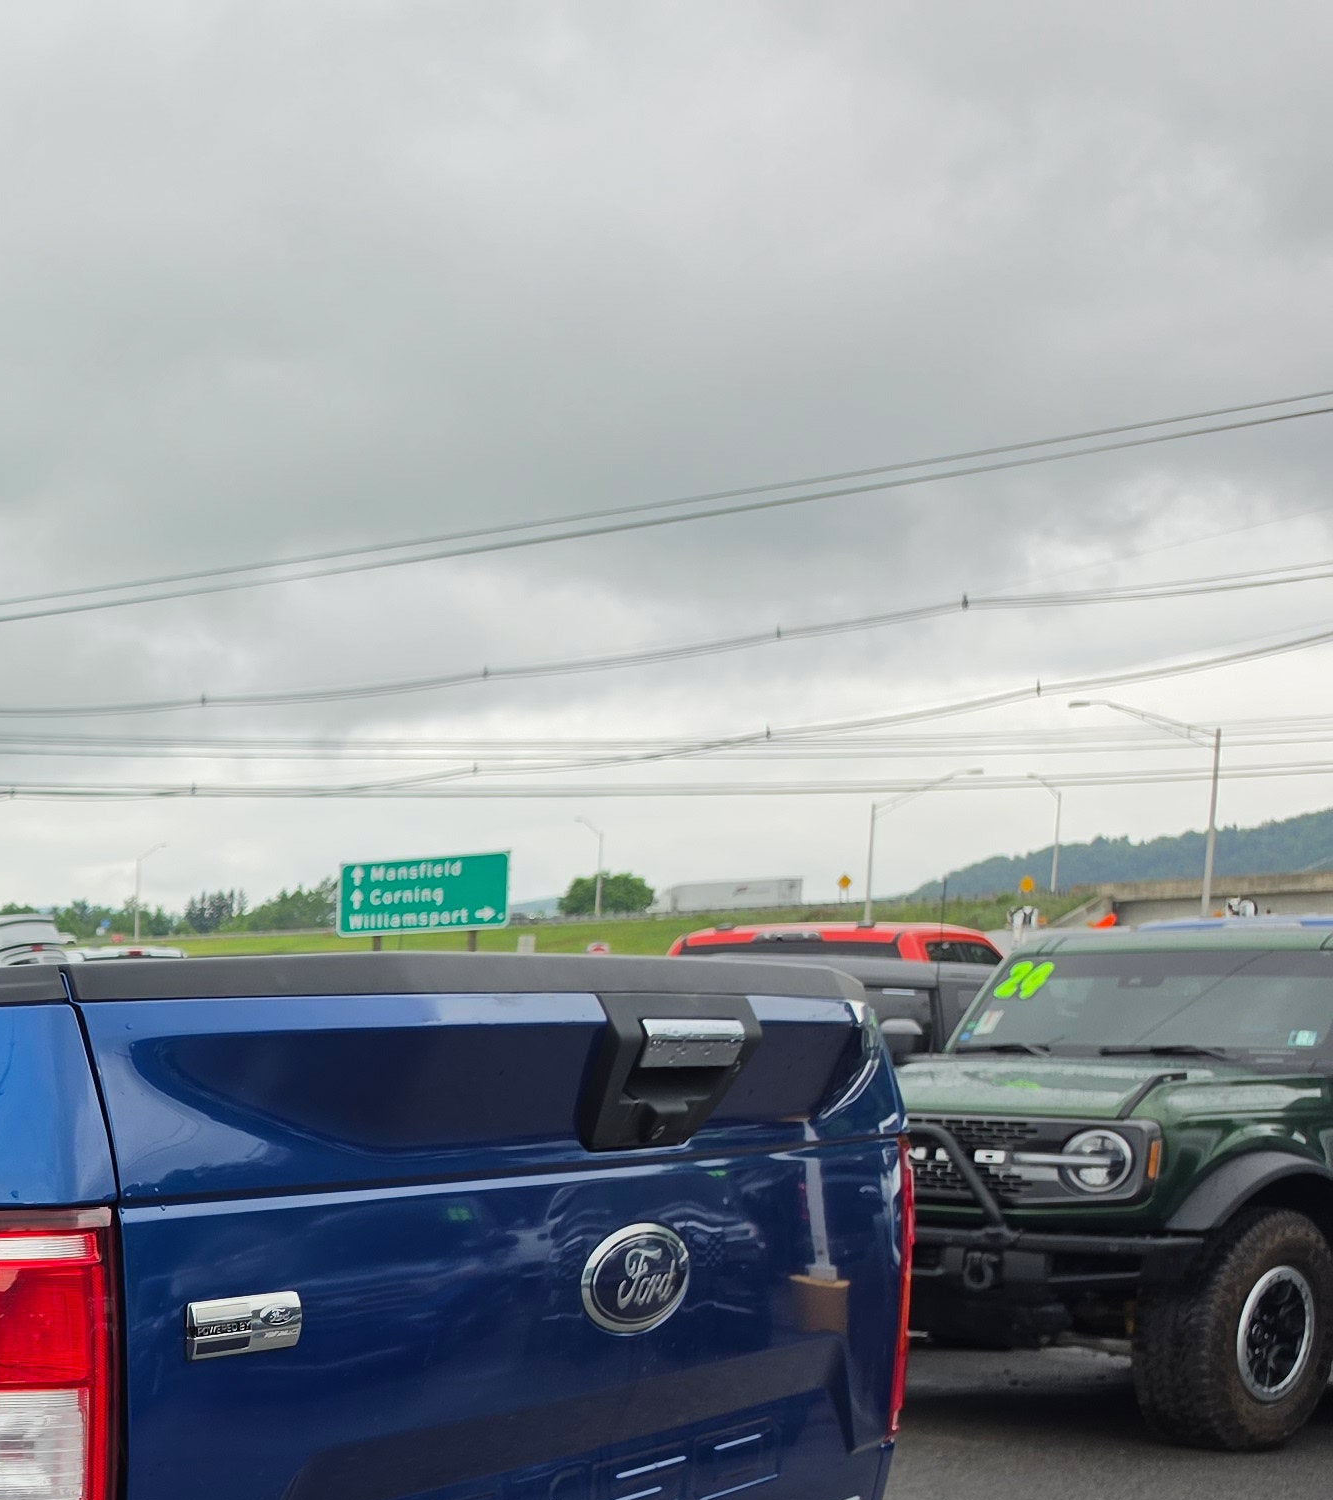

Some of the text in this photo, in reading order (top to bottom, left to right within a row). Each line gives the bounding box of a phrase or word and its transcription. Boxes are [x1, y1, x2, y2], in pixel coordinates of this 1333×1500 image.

[370, 860, 462, 882] Mansfield
[369, 886, 445, 906] Corning
[348, 907, 469, 930] Williamsport
[617, 1248, 676, 1310] Ford
[197, 1321, 251, 1337] POWERED BY
